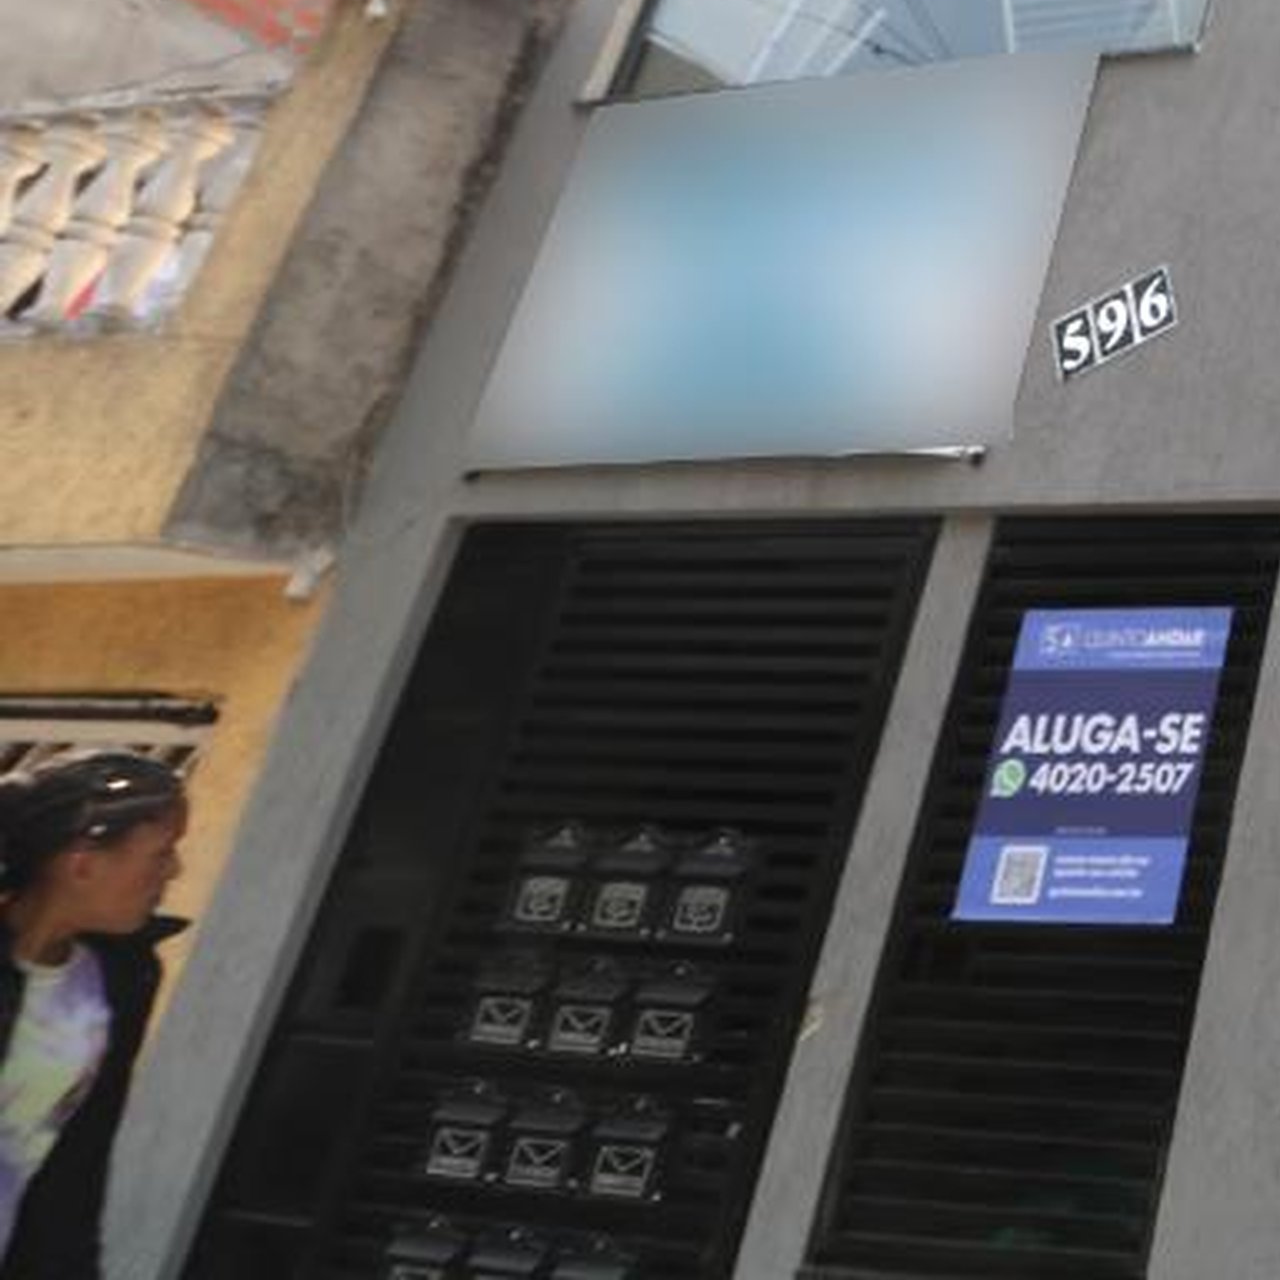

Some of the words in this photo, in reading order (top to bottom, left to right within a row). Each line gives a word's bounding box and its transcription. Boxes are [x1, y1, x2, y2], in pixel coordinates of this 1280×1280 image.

[1062, 277, 1169, 371] 596
[1001, 714, 1205, 754] ALUGA-SE
[1029, 763, 1195, 795] 4020-2507
